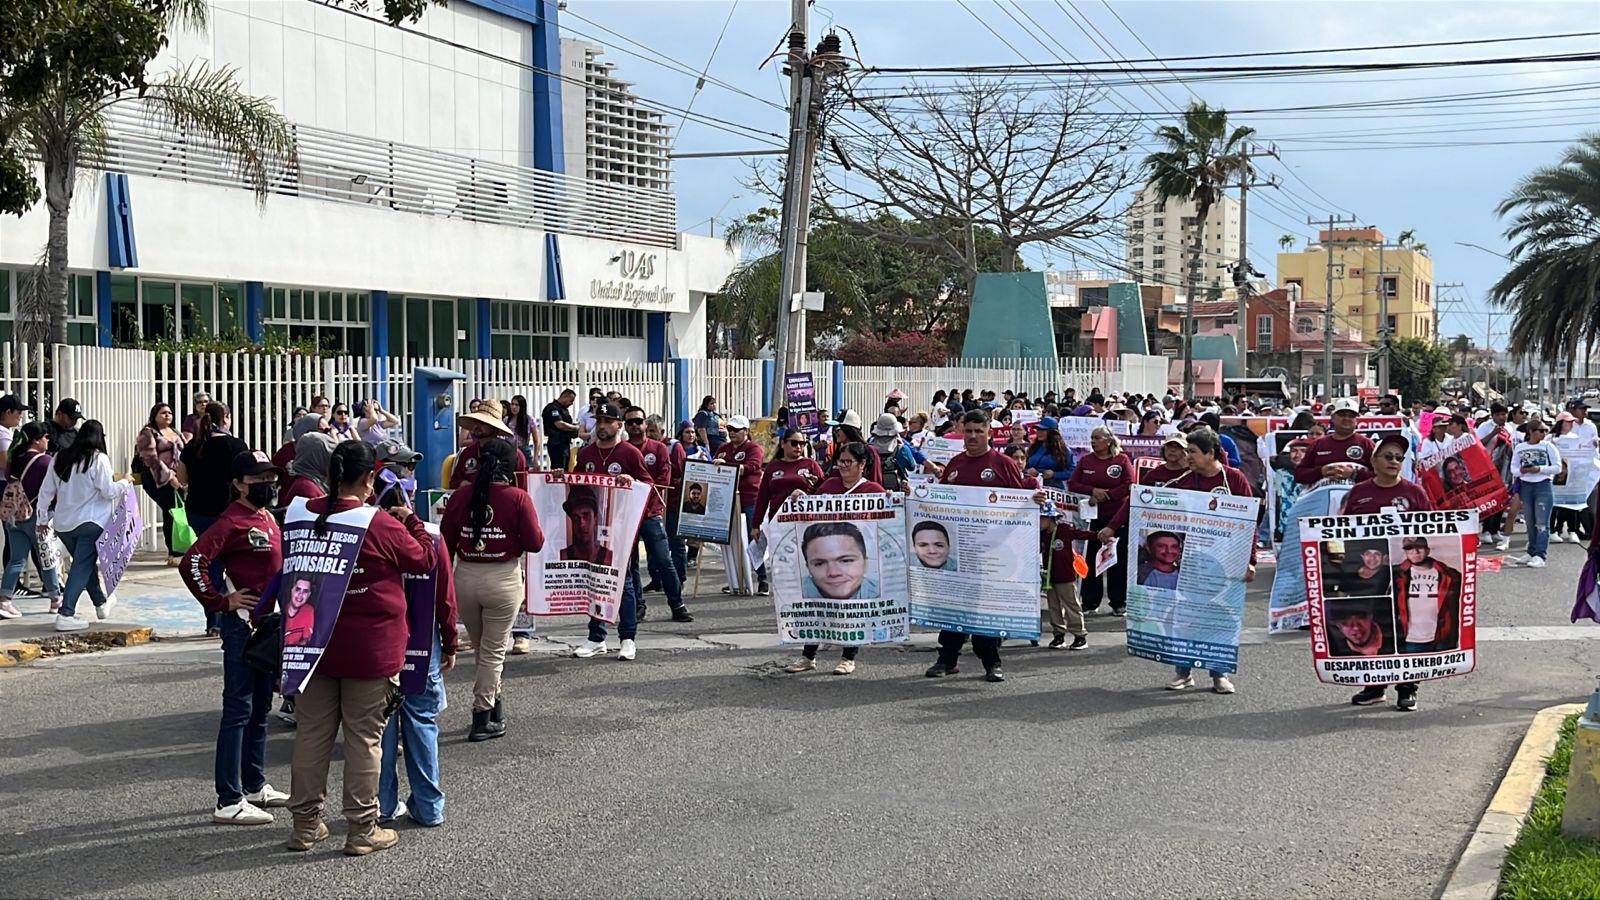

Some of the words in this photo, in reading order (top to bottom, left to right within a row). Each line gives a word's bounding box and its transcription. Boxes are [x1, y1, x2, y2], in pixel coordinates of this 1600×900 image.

[619, 250, 656, 280] UAS
[590, 279, 624, 300] Unidad
[623, 282, 660, 307] Regional
[930, 491, 957, 501] Sinaloa
[1044, 490, 1079, 505] RECIDO
[1154, 497, 1179, 506] Sinaloa
[782, 498, 885, 514] DESAPARECIDO
[972, 508, 1023, 518] encontrar
[1220, 501, 1248, 510] SINALOA
[931, 514, 970, 523] ALEJANDRO
[1190, 517, 1236, 529] encontrar
[1308, 516, 1350, 528] POR
[1356, 513, 1395, 526] LAS
[1399, 510, 1470, 523] VOCES
[125, 516, 136, 542] MI
[1146, 522, 1163, 530] JUAN
[1163, 523, 1176, 531] LUIS
[1191, 526, 1232, 538] RODRÍGUEZ
[1321, 527, 1358, 539] SIN
[1363, 522, 1459, 537] JUSTICIA
[332, 531, 358, 545] RIESGO
[295, 540, 326, 554] ESTADO
[328, 541, 342, 556] ES
[283, 555, 349, 576] RESPONSABLE
[1462, 551, 1476, 627] URGENTE
[840, 602, 869, 610] LIBERTAD
[870, 601, 877, 609] EL
[886, 599, 894, 607] DE
[1304, 546, 1326, 653] DESAPARECIDO
[780, 610, 816, 619] SEPTIEMBRE
[846, 609, 881, 619] MAZATLÁN,
[287, 661, 311, 670] BUSCANDO
[1324, 659, 1401, 671] DESAPARECIDO
[1403, 660, 1410, 669] 8
[1412, 656, 1442, 668] ENERO
[1444, 653, 1466, 665] 2021
[1333, 673, 1360, 684] Cesar
[1363, 671, 1400, 683] Octavio
[1403, 669, 1429, 680] Cantú
